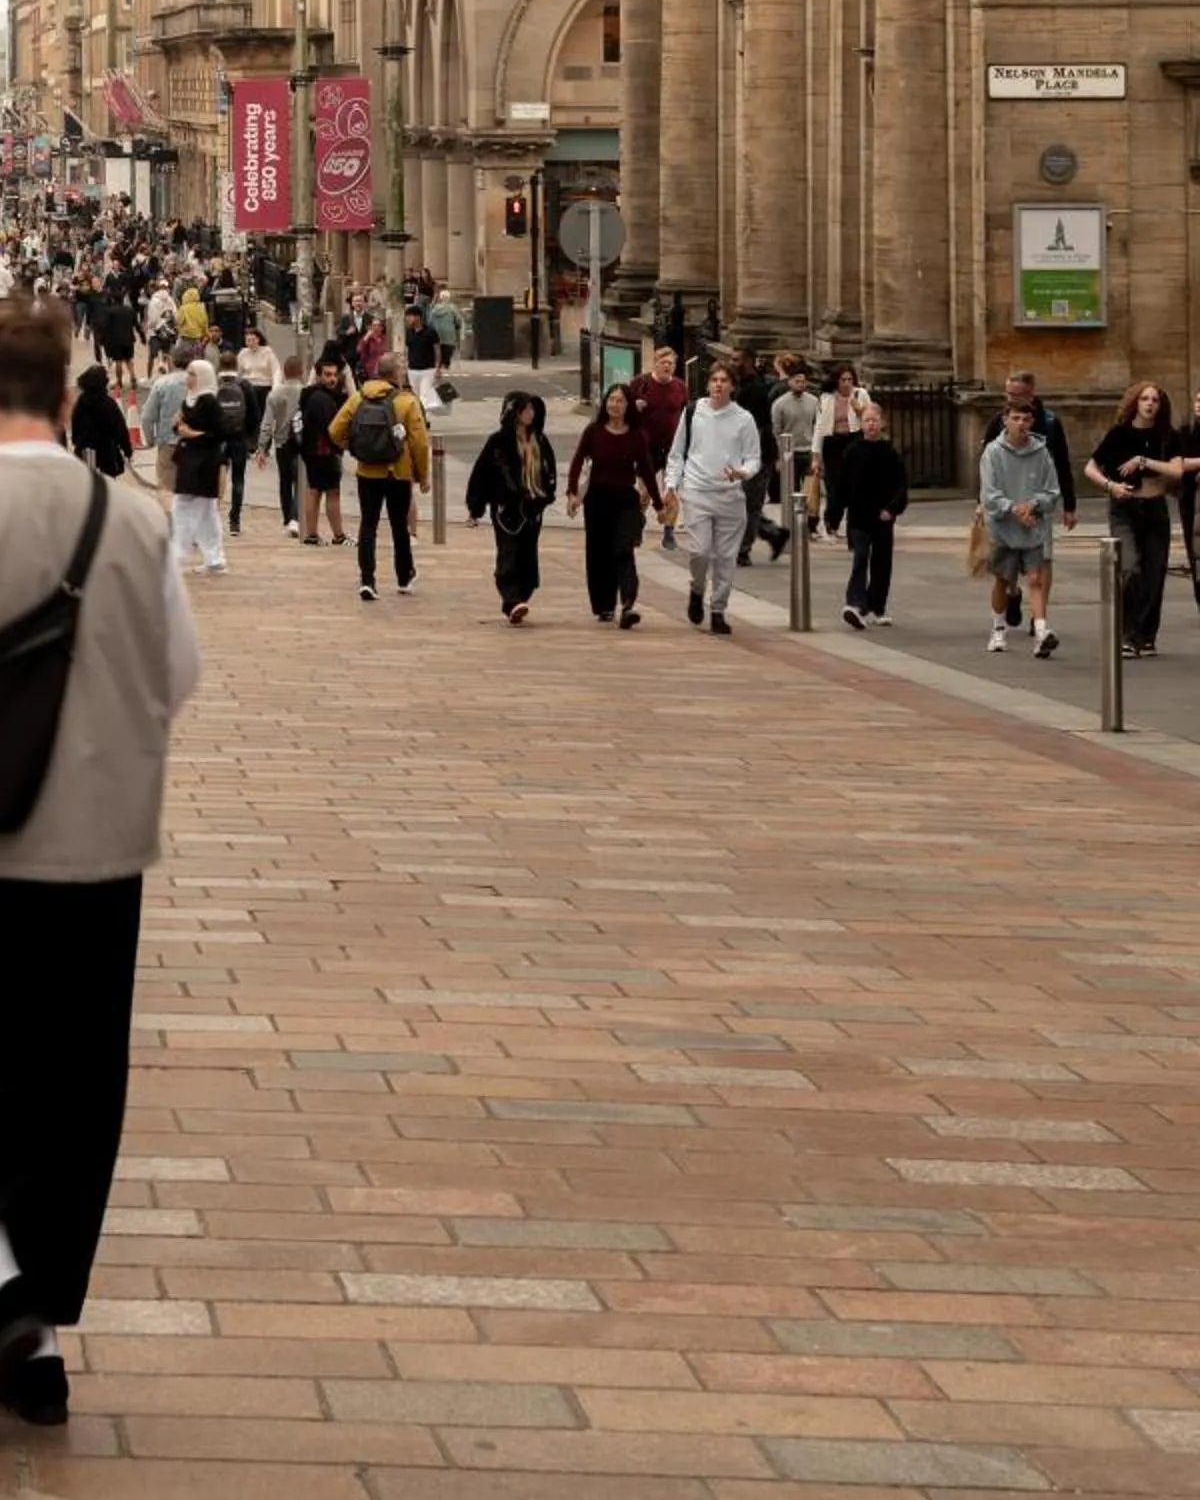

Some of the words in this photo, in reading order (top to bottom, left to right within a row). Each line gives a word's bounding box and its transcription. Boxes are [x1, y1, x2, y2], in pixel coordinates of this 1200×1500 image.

[1035, 80, 1079, 91] PLACE
[262, 109, 281, 161] years
[243, 102, 263, 213] Celebrating
[262, 165, 278, 202] 850
